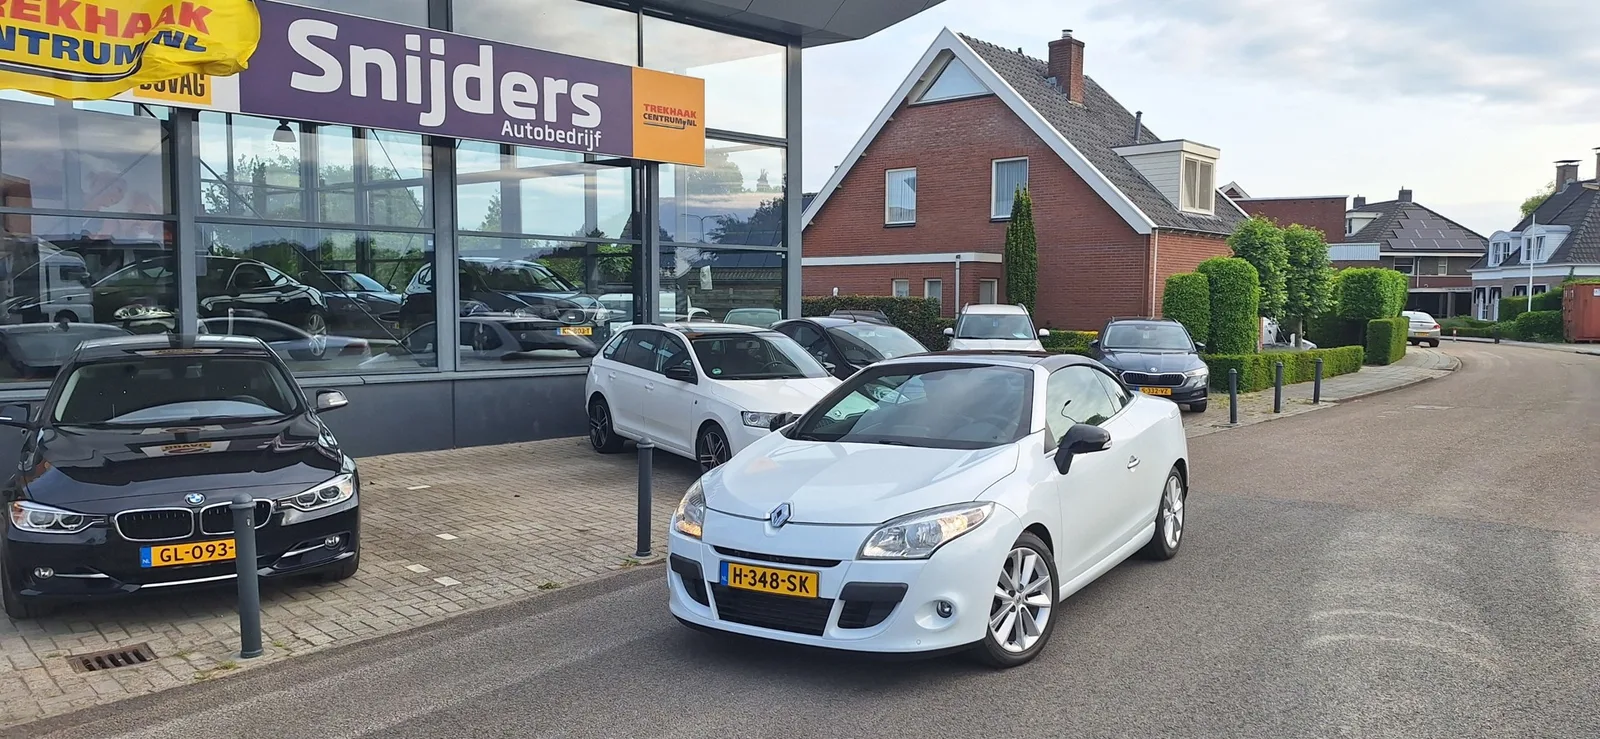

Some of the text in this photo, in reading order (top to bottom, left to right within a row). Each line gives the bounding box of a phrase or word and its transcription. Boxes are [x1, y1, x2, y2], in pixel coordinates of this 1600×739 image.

[0, 0, 213, 39] EKHAAK
[287, 18, 602, 128] Snijders
[643, 103, 697, 119] TREKHAAK
[501, 119, 602, 152] Autobedrijf
[160, 542, 234, 563] GL-093-
[733, 567, 810, 594] H-348-SK
